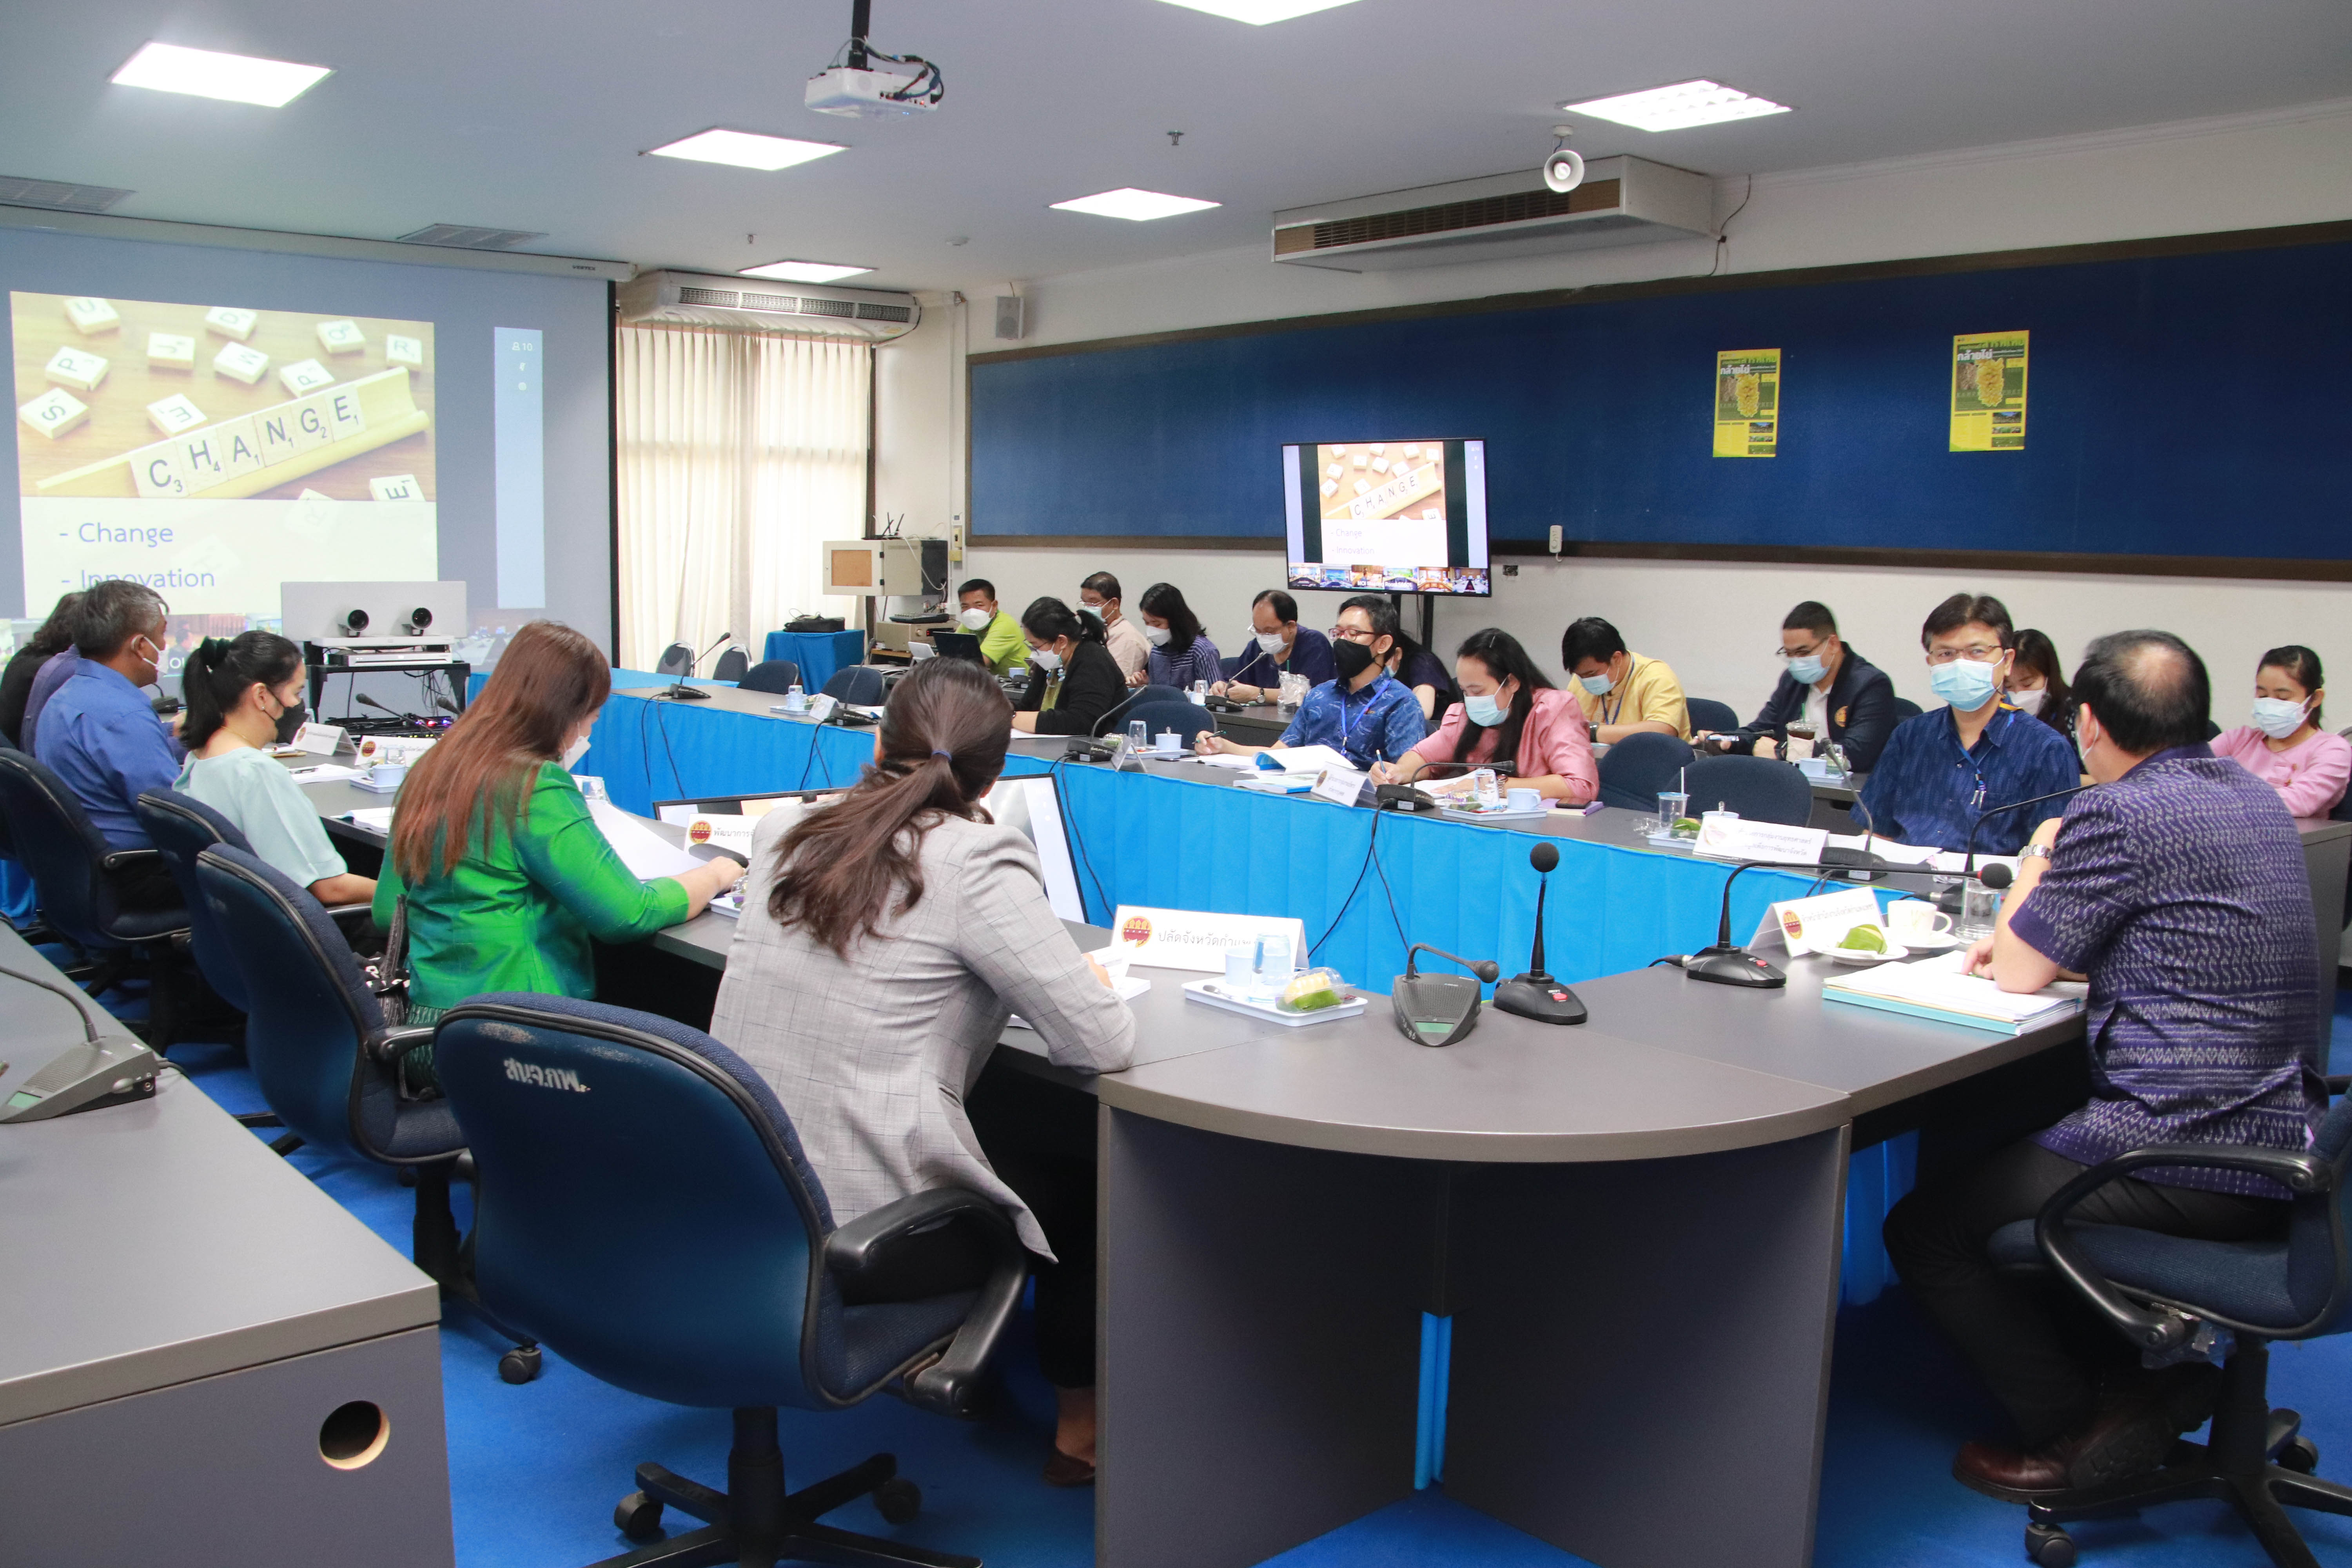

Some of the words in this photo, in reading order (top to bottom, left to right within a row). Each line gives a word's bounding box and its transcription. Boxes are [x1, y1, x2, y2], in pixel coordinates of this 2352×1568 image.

[522, 343, 533, 351] 10
[79, 522, 174, 548] Change
[1336, 528, 1362, 539] Change
[1336, 546, 1375, 554] Innovation
